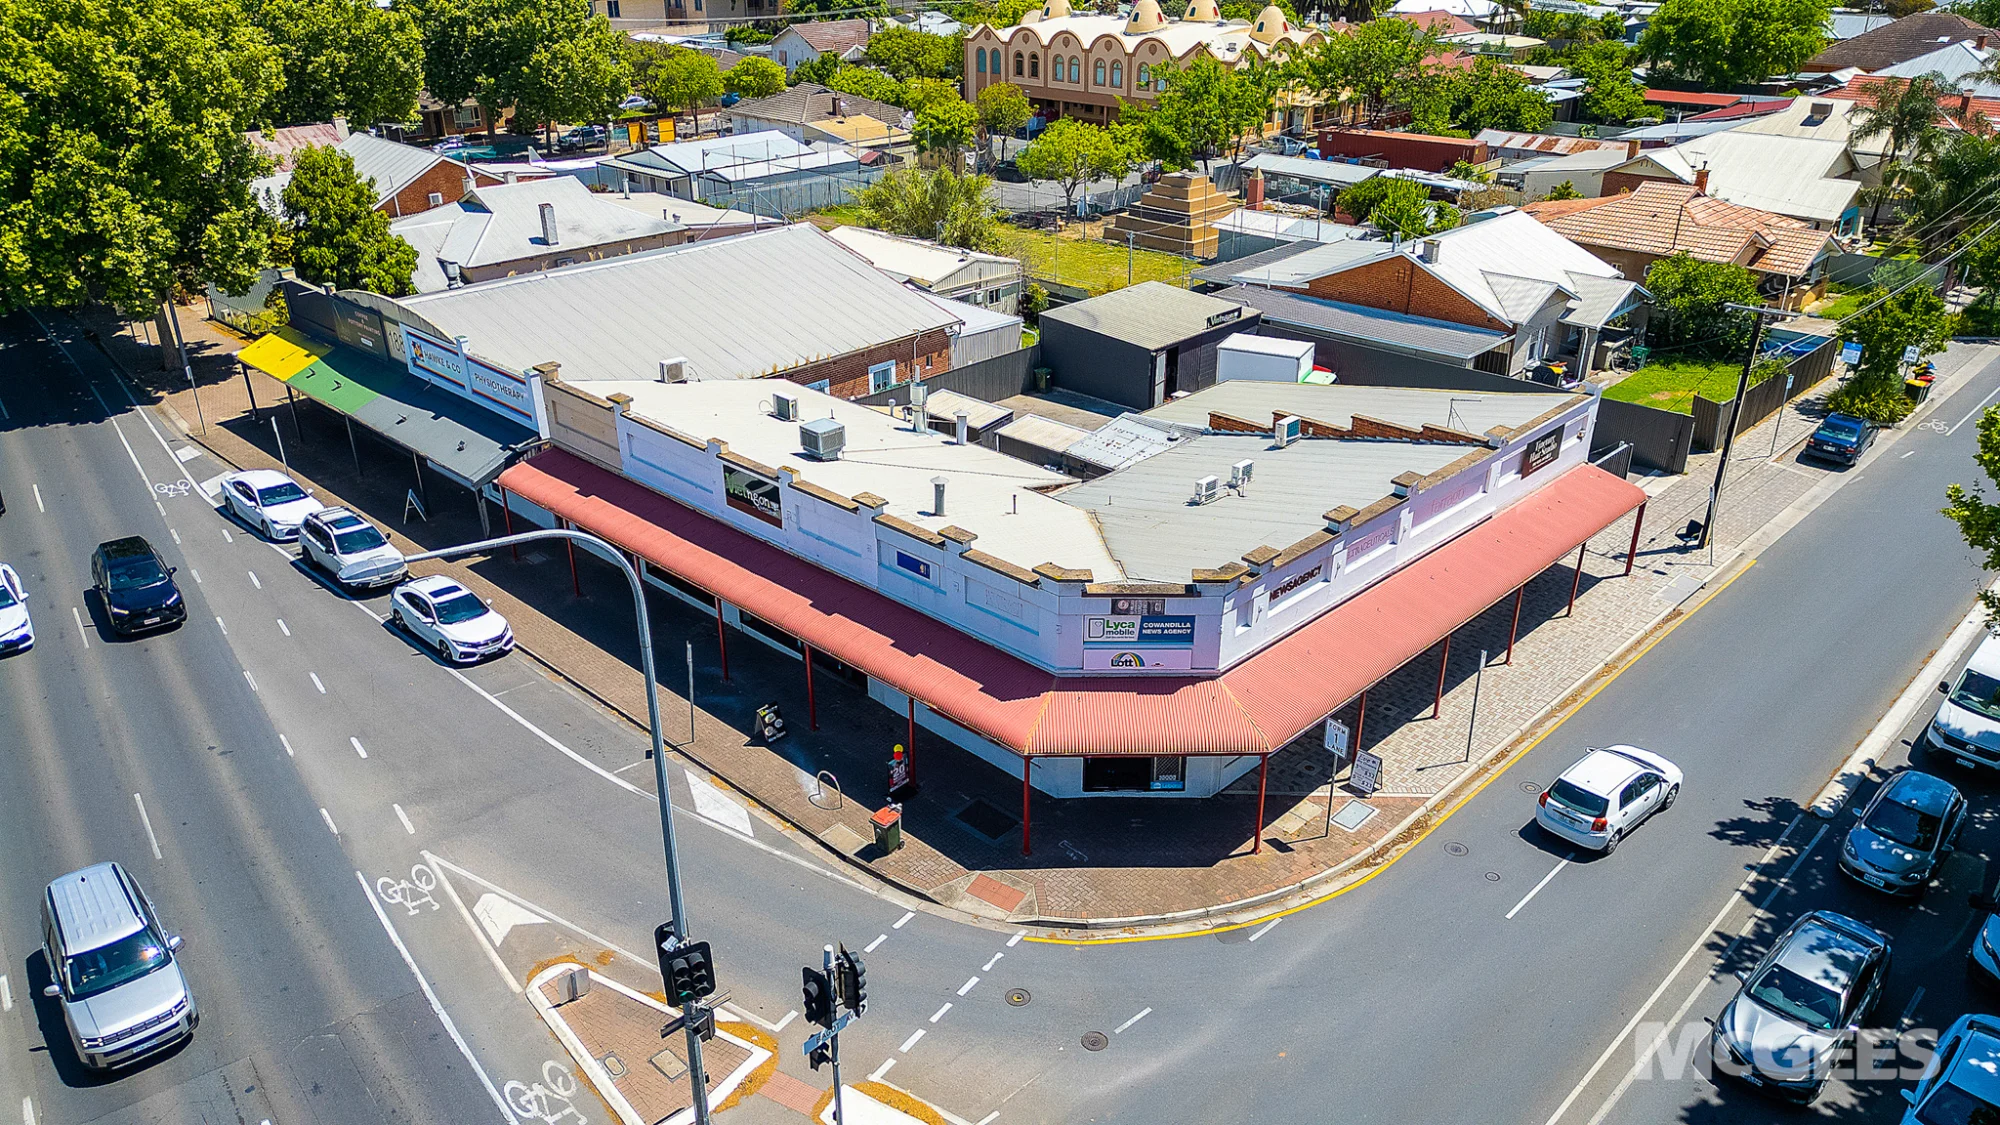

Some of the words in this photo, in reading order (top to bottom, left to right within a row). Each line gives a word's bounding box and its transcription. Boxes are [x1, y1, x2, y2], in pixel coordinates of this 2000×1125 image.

[424, 350, 445, 368] HAWKE
[446, 360, 451, 370] &
[452, 362, 461, 374] CO
[474, 372, 525, 402] PHYSIOTHERAPY
[1269, 564, 1323, 602] NEWSAGENCY
[1106, 619, 1136, 630] Lyca
[1105, 628, 1135, 636] mobile
[1110, 658, 1134, 667] Lott
[1328, 722, 1346, 735] FORM
[1334, 733, 1339, 743] 1
[1327, 741, 1344, 754] LANE
